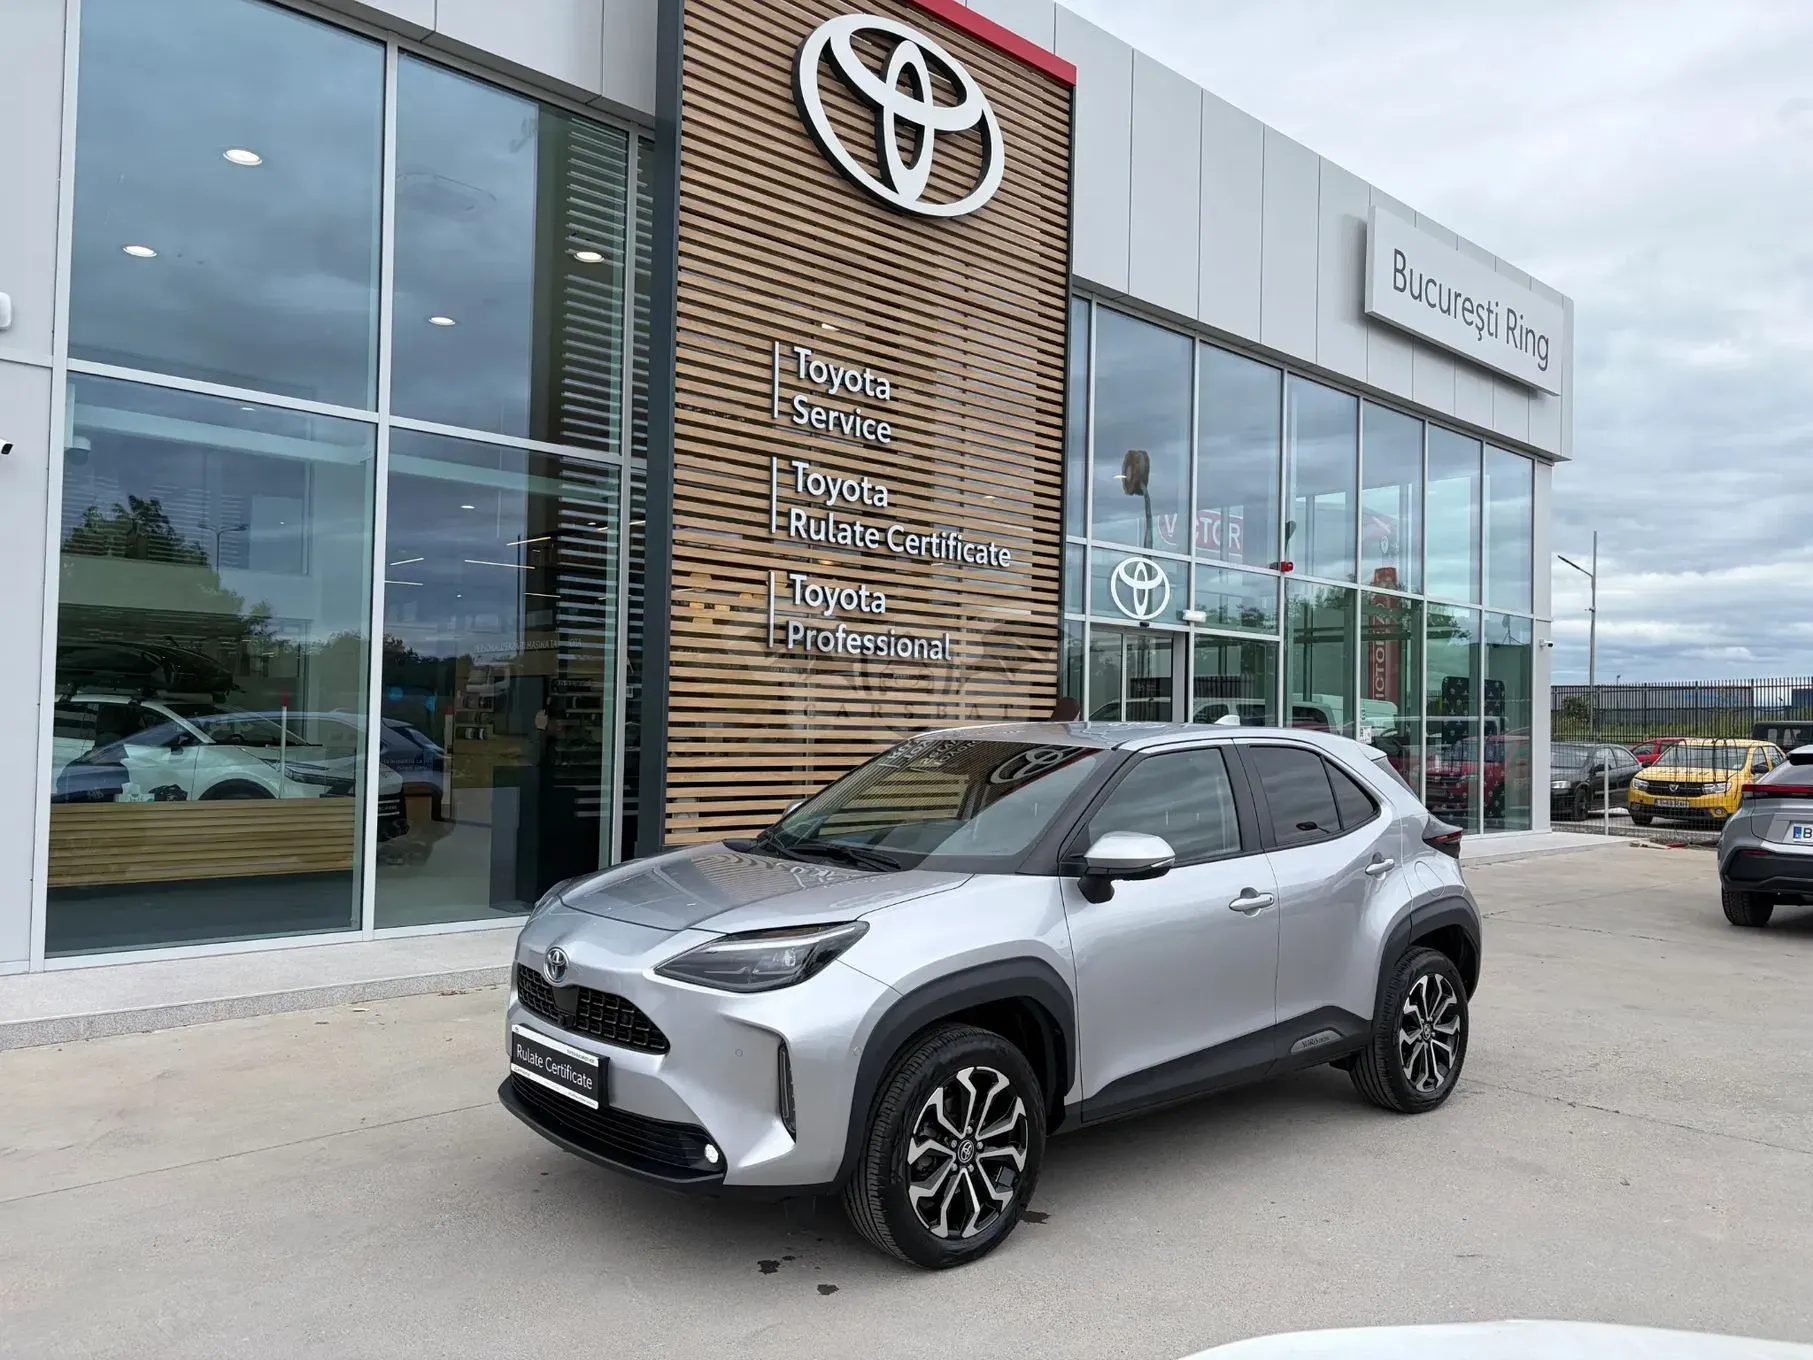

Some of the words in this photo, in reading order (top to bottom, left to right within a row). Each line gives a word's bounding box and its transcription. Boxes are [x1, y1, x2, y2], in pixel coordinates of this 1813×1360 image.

[1506, 307, 1549, 371] Ring
[793, 345, 891, 400] Toyota
[792, 395, 892, 444] Service
[791, 460, 888, 508] Toyota
[788, 508, 879, 549] Rulate
[886, 524, 1012, 568] Certificate
[1164, 513, 1240, 550] VTOR
[788, 573, 886, 616] Toyota
[786, 620, 951, 661] Professional
[516, 1043, 544, 1068] Rulate
[545, 1056, 593, 1090] Certificate
